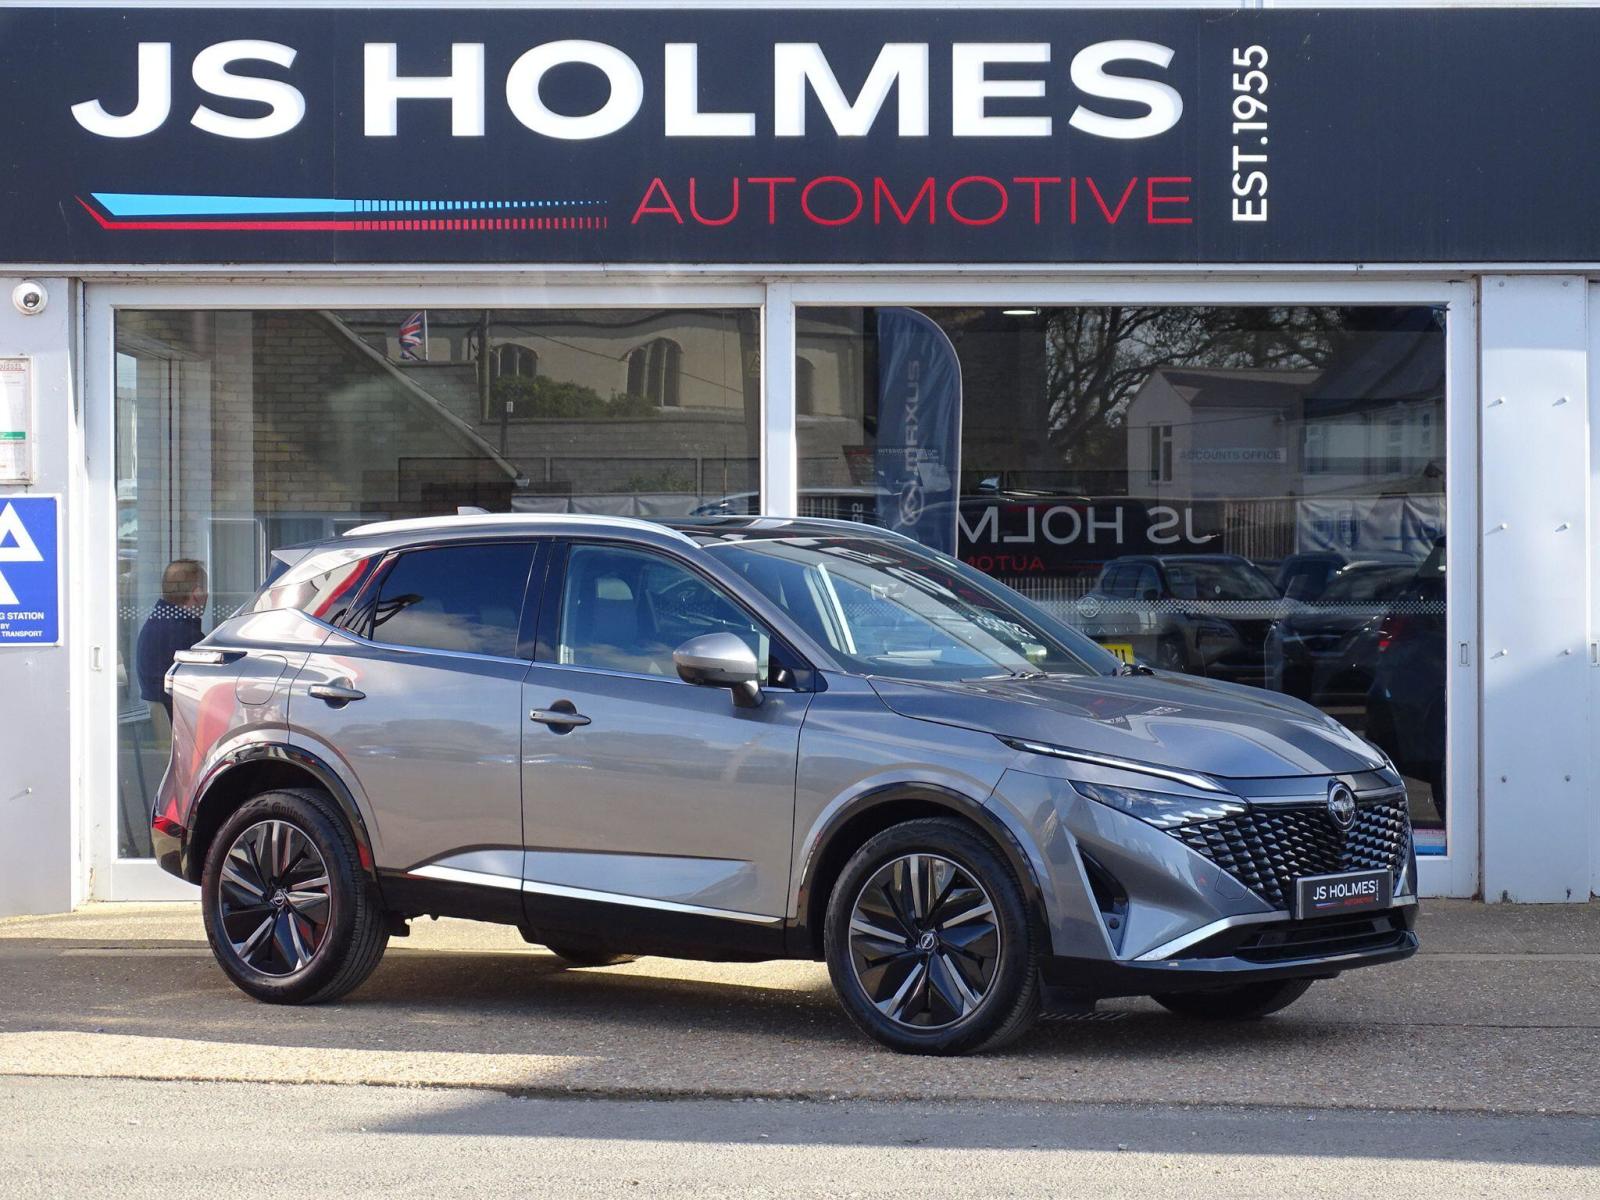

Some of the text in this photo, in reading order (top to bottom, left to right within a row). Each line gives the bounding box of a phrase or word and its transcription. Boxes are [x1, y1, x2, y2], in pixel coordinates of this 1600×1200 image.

[70, 39, 1184, 140] JS HOLMES
[1231, 44, 1269, 222] EST.1955
[630, 175, 1193, 226] AUTOMOTIVE
[7, 612, 44, 620] STATION
[1313, 886, 1327, 900] JS
[1329, 880, 1376, 898] HOLMES
